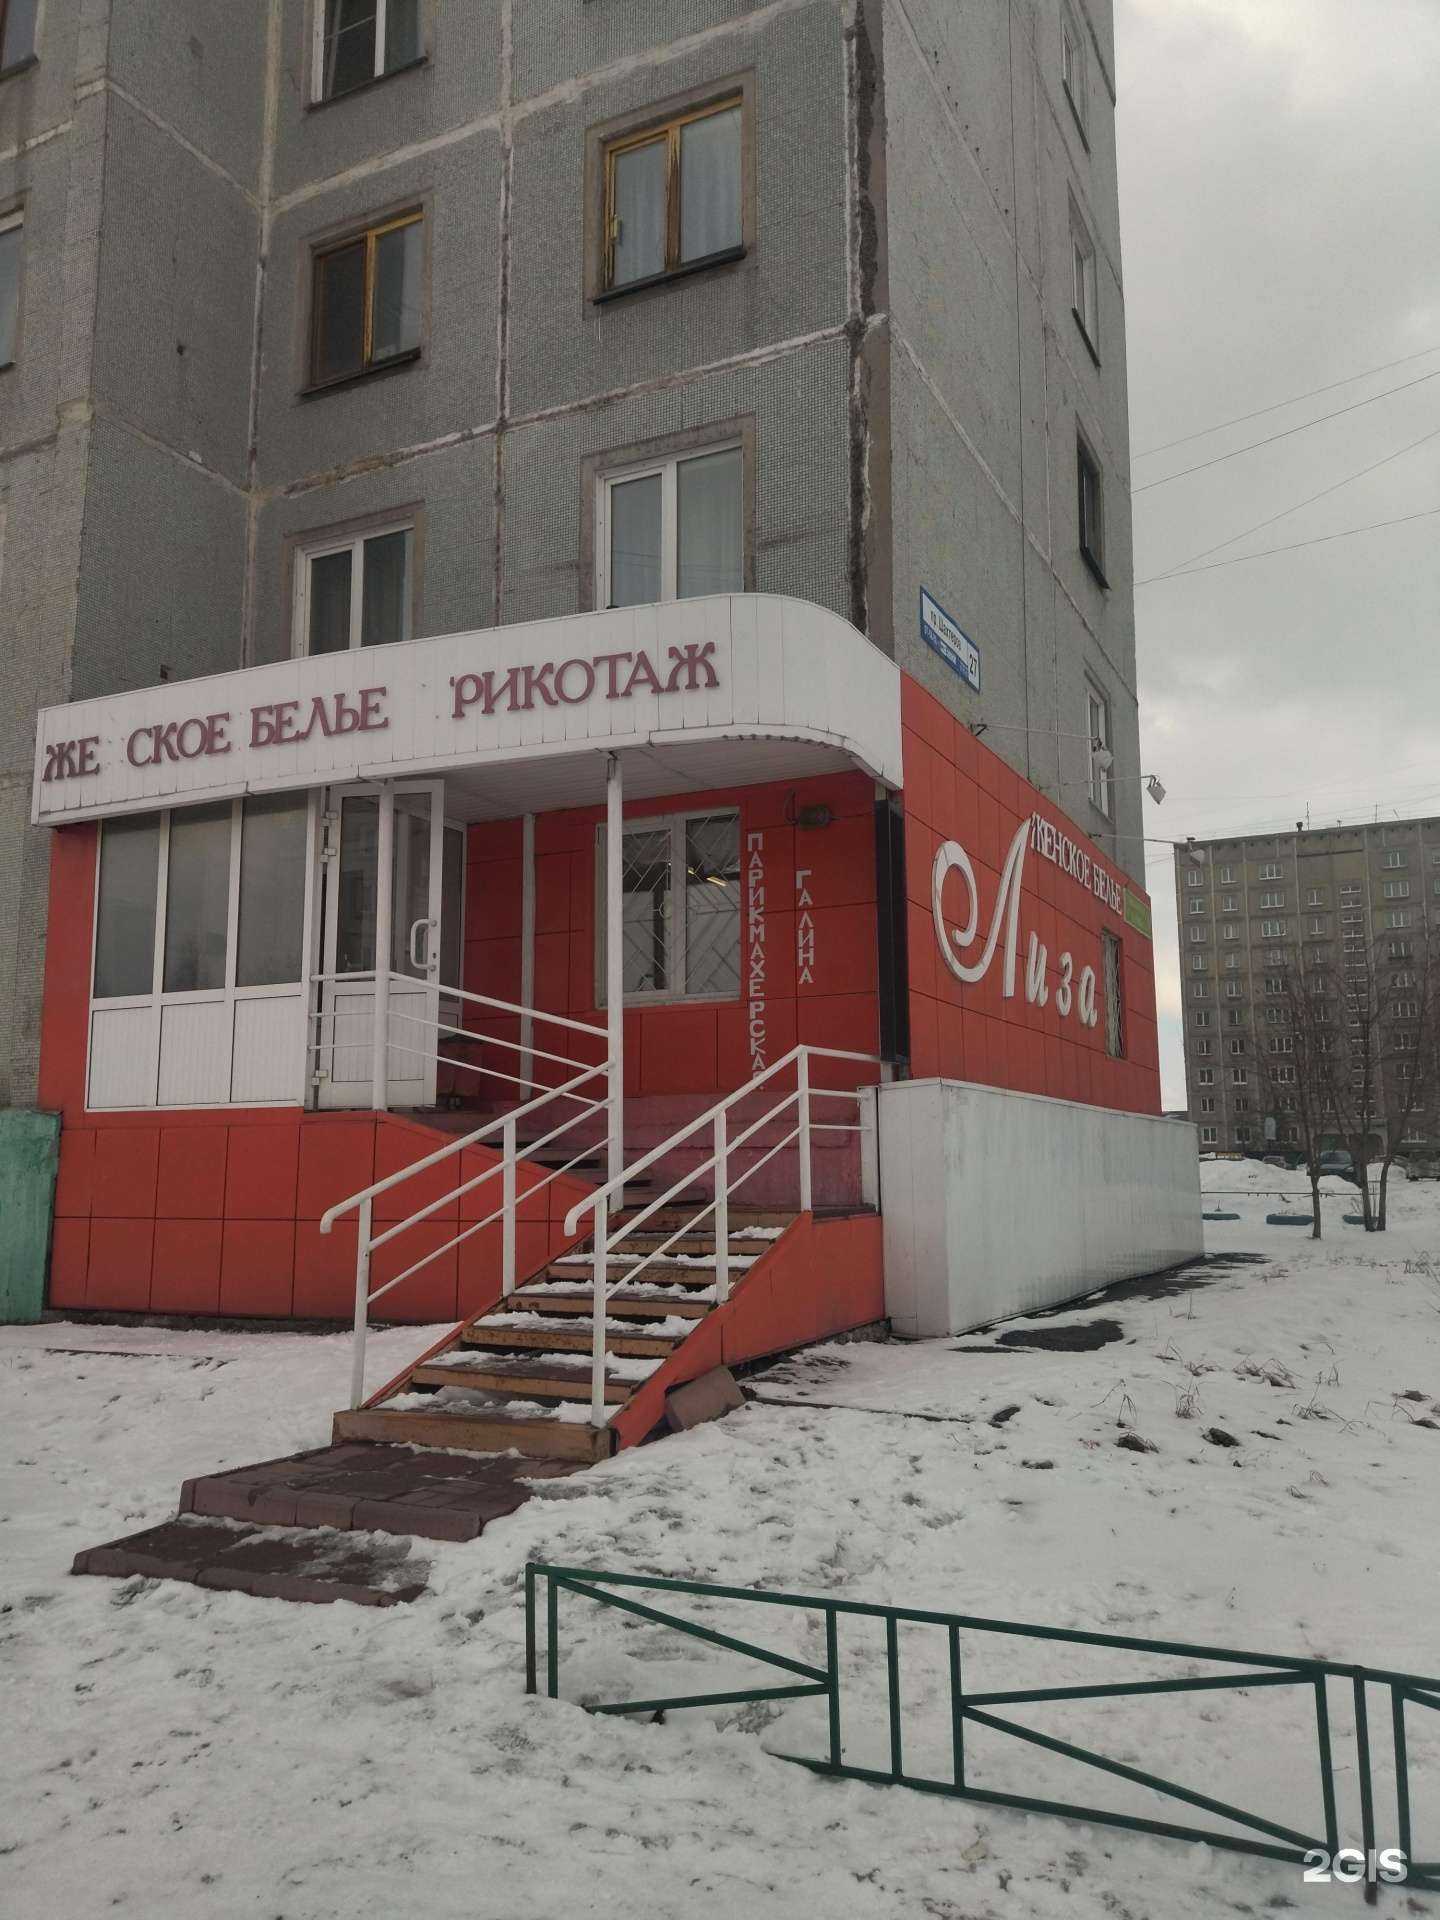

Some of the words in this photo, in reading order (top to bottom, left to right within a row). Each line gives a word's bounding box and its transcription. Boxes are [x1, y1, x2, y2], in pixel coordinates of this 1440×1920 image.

[450, 641, 720, 719] РИКОТАЖ
[969, 653, 978, 677] 27
[249, 686, 389, 749] БЕЛЬЕ
[1030, 811, 1092, 891] ЖЕНСКОЕ
[1092, 862, 1122, 916] БЕЛЬЕ
[796, 869, 814, 985] ГАЛИНА
[931, 817, 1098, 1027] Лиза
